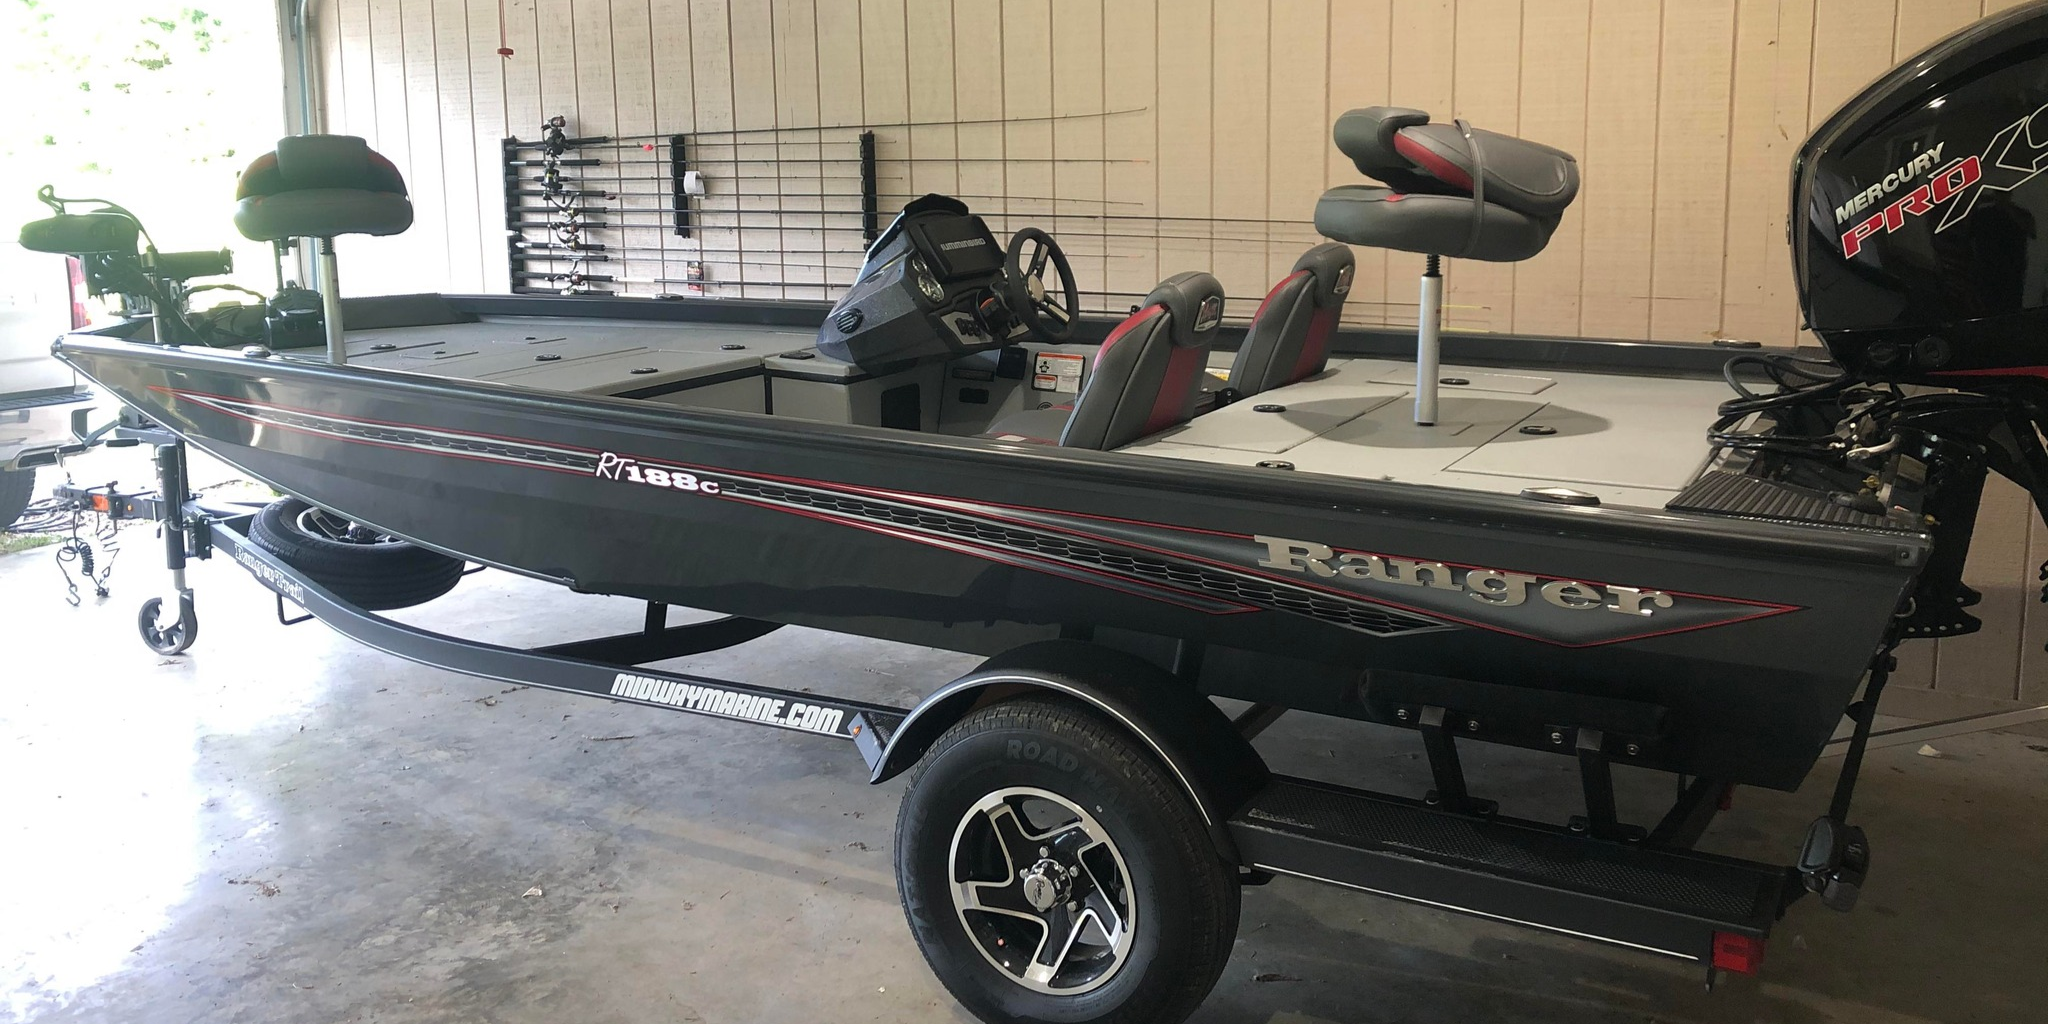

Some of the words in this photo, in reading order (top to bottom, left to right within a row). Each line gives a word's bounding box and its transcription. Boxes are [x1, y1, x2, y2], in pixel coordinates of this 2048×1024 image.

[1835, 141, 1945, 225] MERCURY
[1841, 155, 1982, 260] PRO
[234, 543, 275, 583] Ranger
[274, 569, 304, 604] Trail
[1254, 534, 1674, 617] Ranger
[610, 673, 844, 734] MIDWAYMARINE.COM
[1006, 739, 1079, 773] ROAD
